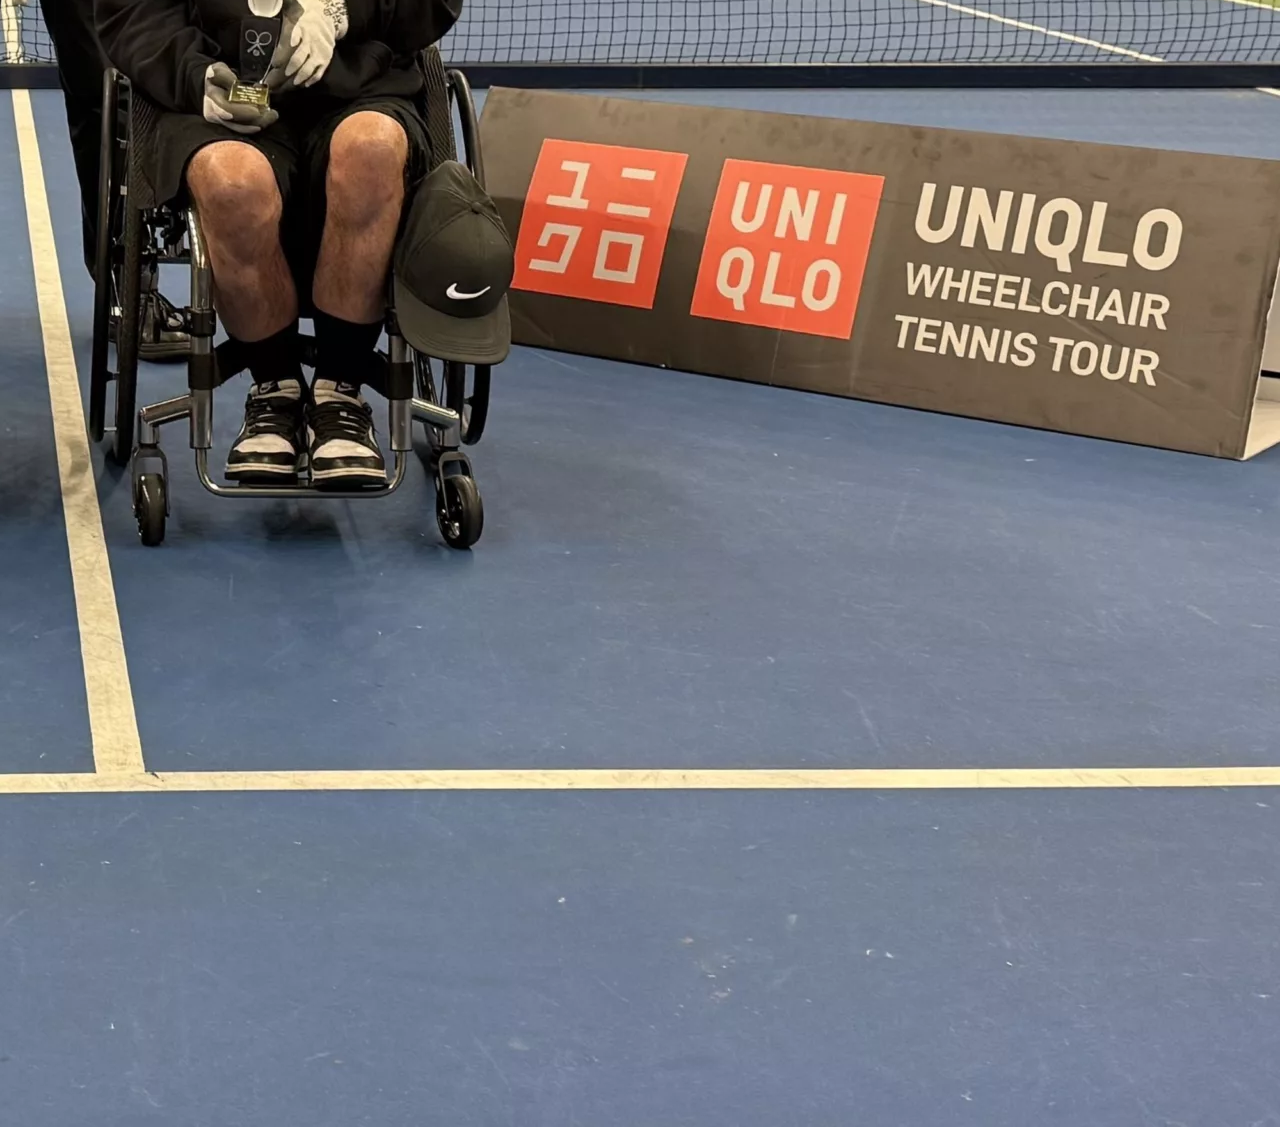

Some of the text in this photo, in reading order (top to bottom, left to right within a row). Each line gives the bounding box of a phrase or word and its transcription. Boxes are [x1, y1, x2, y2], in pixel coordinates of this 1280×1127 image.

[730, 181, 848, 246] UNI
[914, 182, 1183, 273] UNIQLO
[715, 246, 842, 312] QLO
[906, 261, 1171, 331] WHEELCHAIR
[894, 314, 1161, 387] TENNIS TOUR
